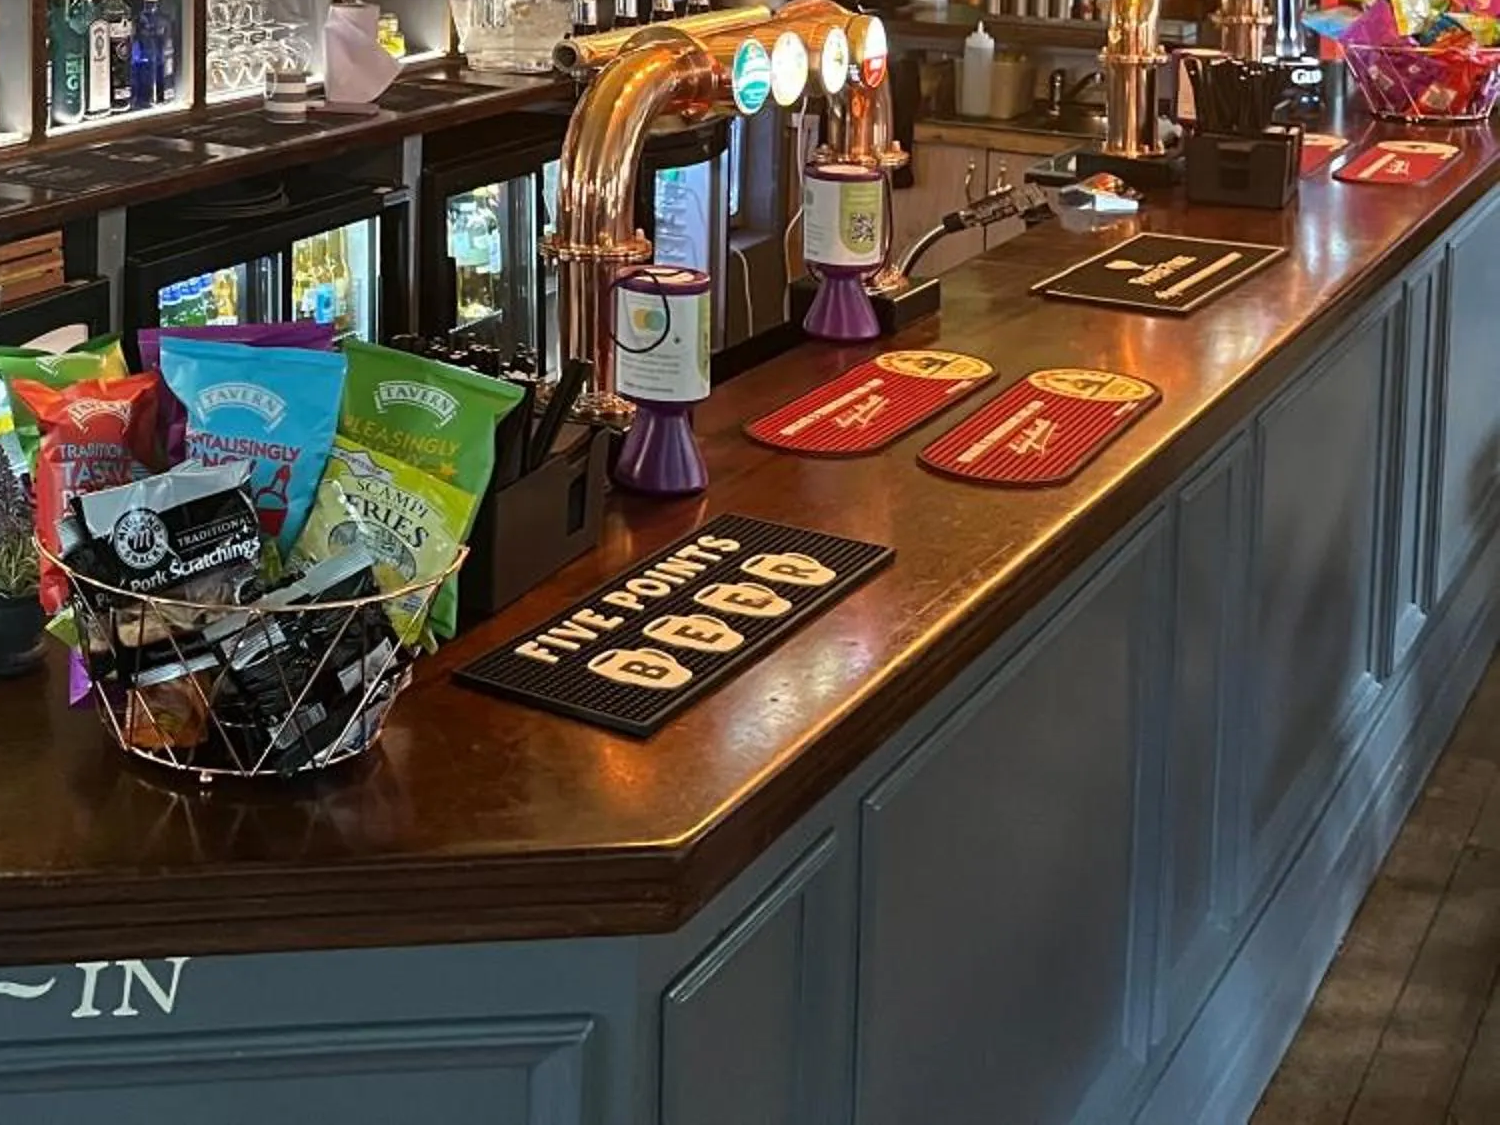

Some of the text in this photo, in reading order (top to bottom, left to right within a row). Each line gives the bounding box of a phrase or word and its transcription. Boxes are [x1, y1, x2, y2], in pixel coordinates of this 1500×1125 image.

[204, 388, 279, 413] TAVERN
[385, 386, 453, 413] TAVERN
[356, 479, 429, 518] SCAMPI
[176, 515, 252, 548] TRADITIONAL
[344, 493, 430, 549] FRIES
[130, 536, 261, 593] Pork Scratchings
[514, 535, 741, 664] FIVE POINTS
